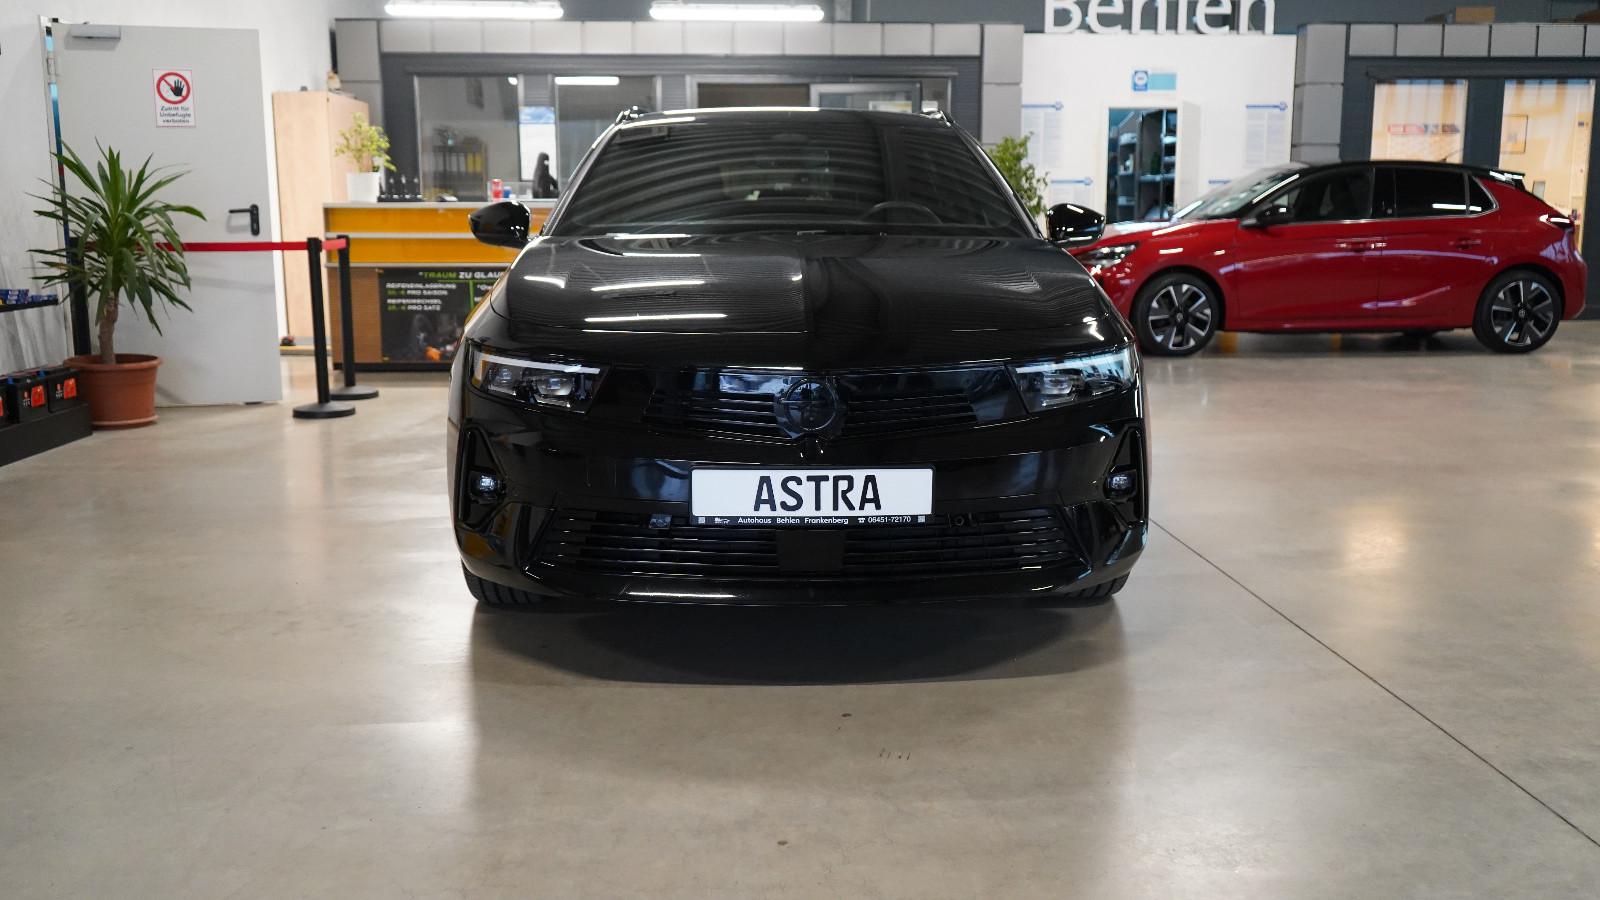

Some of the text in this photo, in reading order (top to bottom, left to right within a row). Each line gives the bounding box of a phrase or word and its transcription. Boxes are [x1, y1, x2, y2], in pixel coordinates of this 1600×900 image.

[458, 271, 472, 279] ZU
[753, 474, 882, 512] ASTRA
[804, 517, 849, 525] Frankenberg
